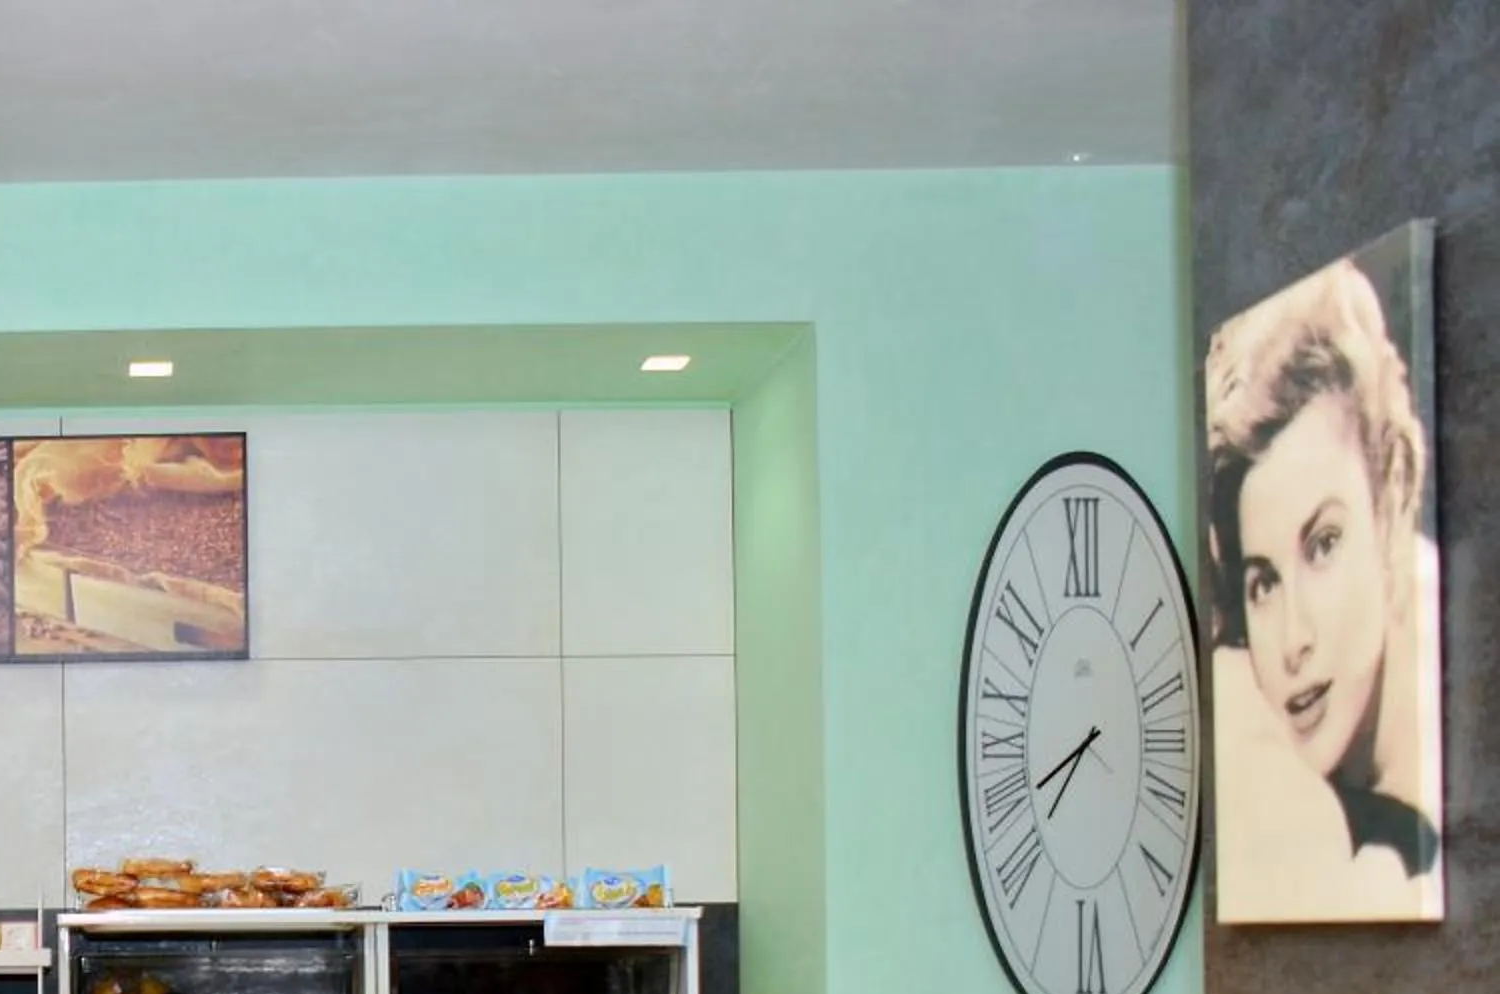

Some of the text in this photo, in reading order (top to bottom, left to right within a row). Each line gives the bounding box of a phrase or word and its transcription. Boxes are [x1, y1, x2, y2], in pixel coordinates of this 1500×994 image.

[1062, 497, 1100, 597] XII
[995, 580, 1044, 667] XI
[1130, 597, 1164, 652] I
[982, 677, 1029, 718] X
[1141, 672, 1185, 714] II
[981, 731, 1025, 760] IX
[1144, 728, 1185, 754] III
[984, 767, 1028, 834] VIII
[1146, 769, 1186, 820] IV
[996, 826, 1043, 911] VII
[1138, 841, 1174, 897] V
